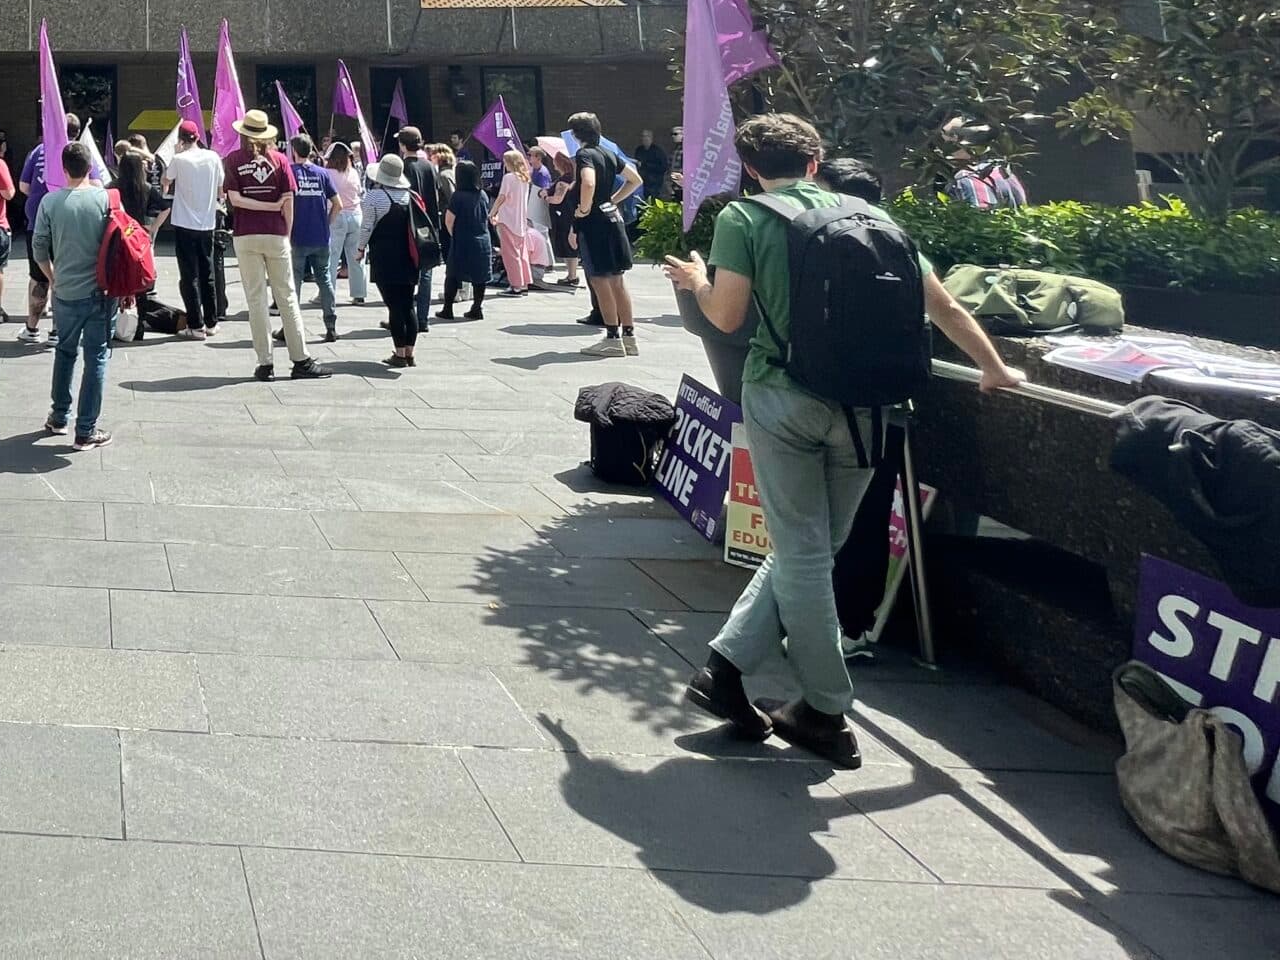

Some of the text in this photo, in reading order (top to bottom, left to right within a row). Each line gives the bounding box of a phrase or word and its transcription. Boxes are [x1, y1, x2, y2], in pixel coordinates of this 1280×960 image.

[696, 395, 722, 421] official
[674, 407, 732, 479] PICKET
[655, 449, 698, 507] LINE
[732, 530, 774, 550] EDU
